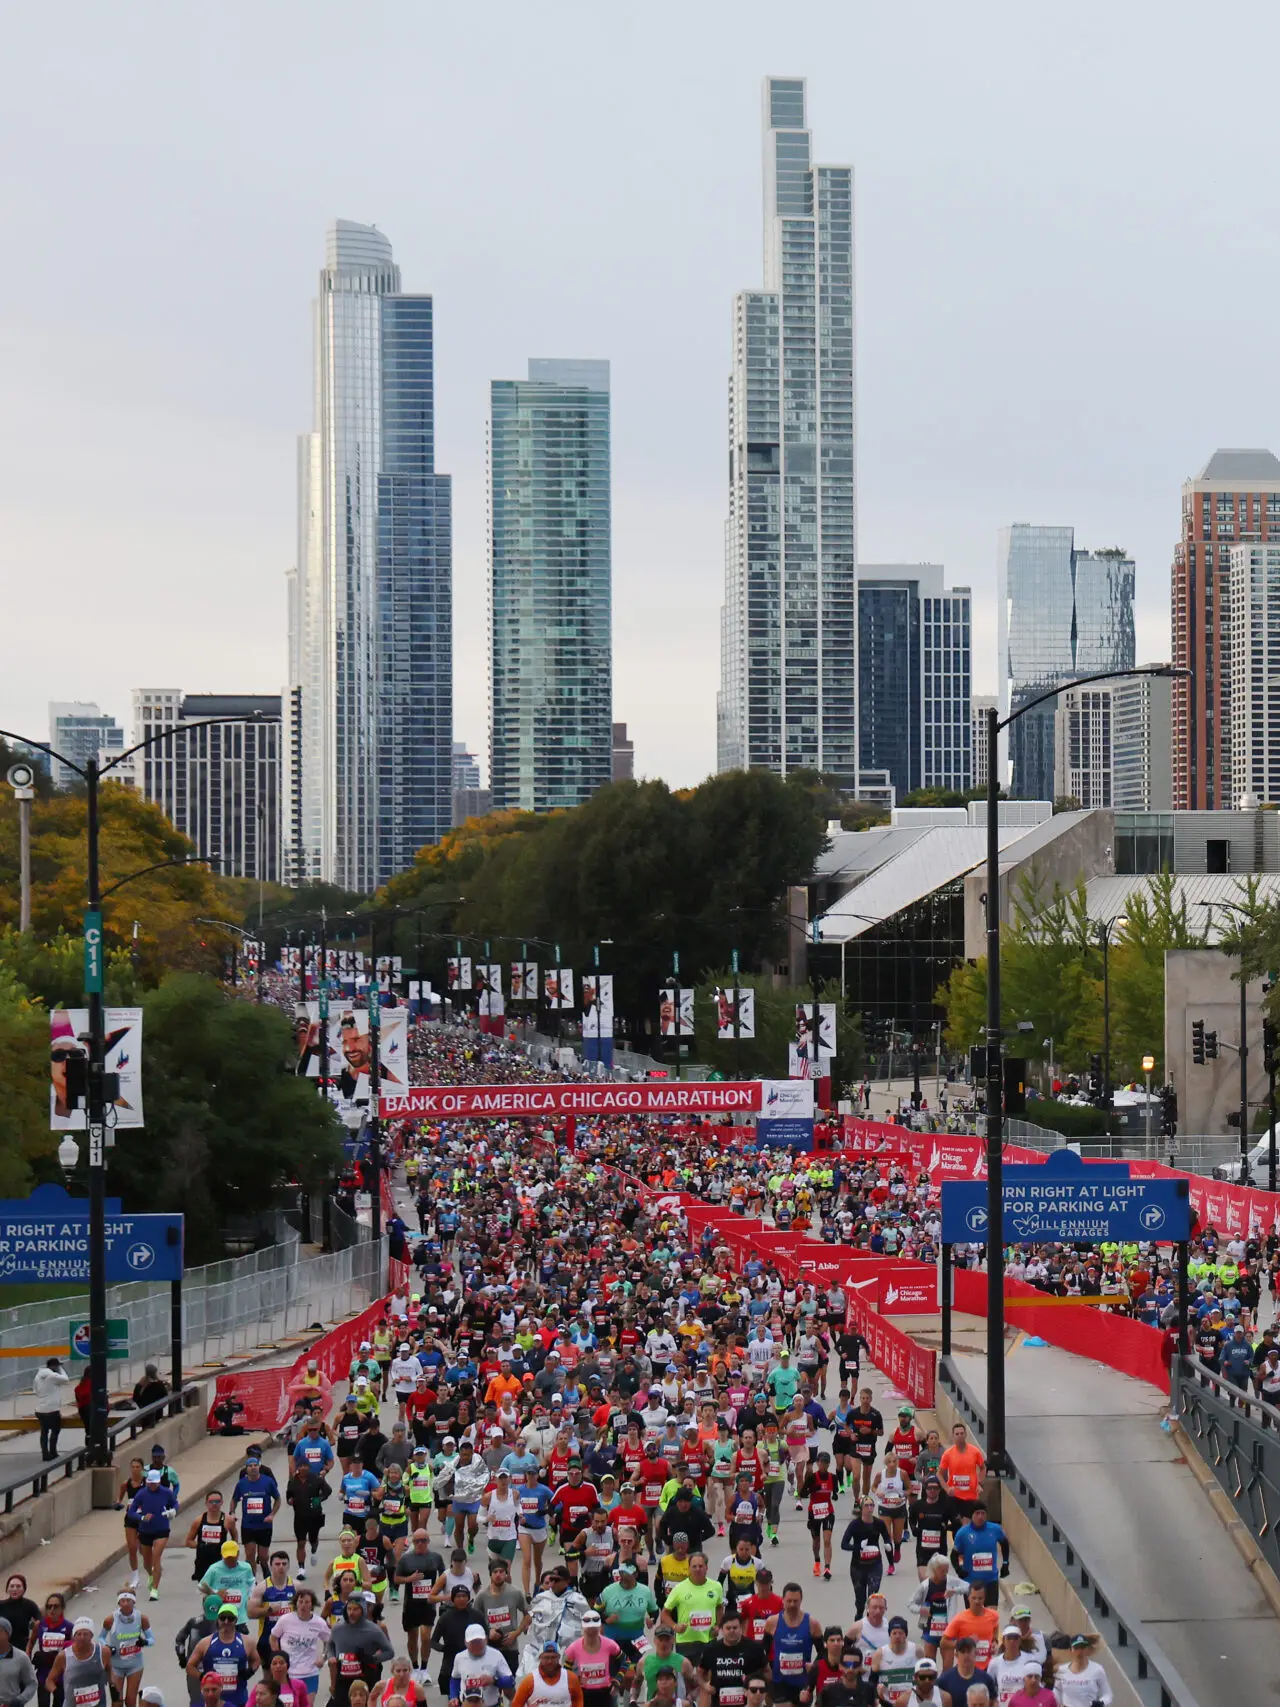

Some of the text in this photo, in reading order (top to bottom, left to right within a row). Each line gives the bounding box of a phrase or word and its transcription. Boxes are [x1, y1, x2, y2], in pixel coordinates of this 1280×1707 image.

[86, 928, 100, 977] C11
[386, 1096, 438, 1112] BANK
[442, 1094, 467, 1110] OF
[472, 1092, 556, 1110] AMERICA
[560, 1092, 642, 1108] CHICAGO
[648, 1090, 752, 1106] MARATHON
[92, 1127, 101, 1162] C11
[942, 1153, 962, 1163] Chicago
[941, 1162, 967, 1171] Marathon
[1030, 1186, 1074, 1198] RIGHT
[1079, 1186, 1098, 1197] AT
[1103, 1186, 1146, 1196] LIGHT
[1004, 1201, 1128, 1212] FOR PARKING AT
[6, 1224, 55, 1236] RIGHT
[60, 1224, 82, 1236] AT
[1031, 1220, 1109, 1228] MILLENNIUM
[1059, 1229, 1109, 1237] GARAGES
[15, 1239, 88, 1252] PARKING
[104, 1239, 114, 1250] T
